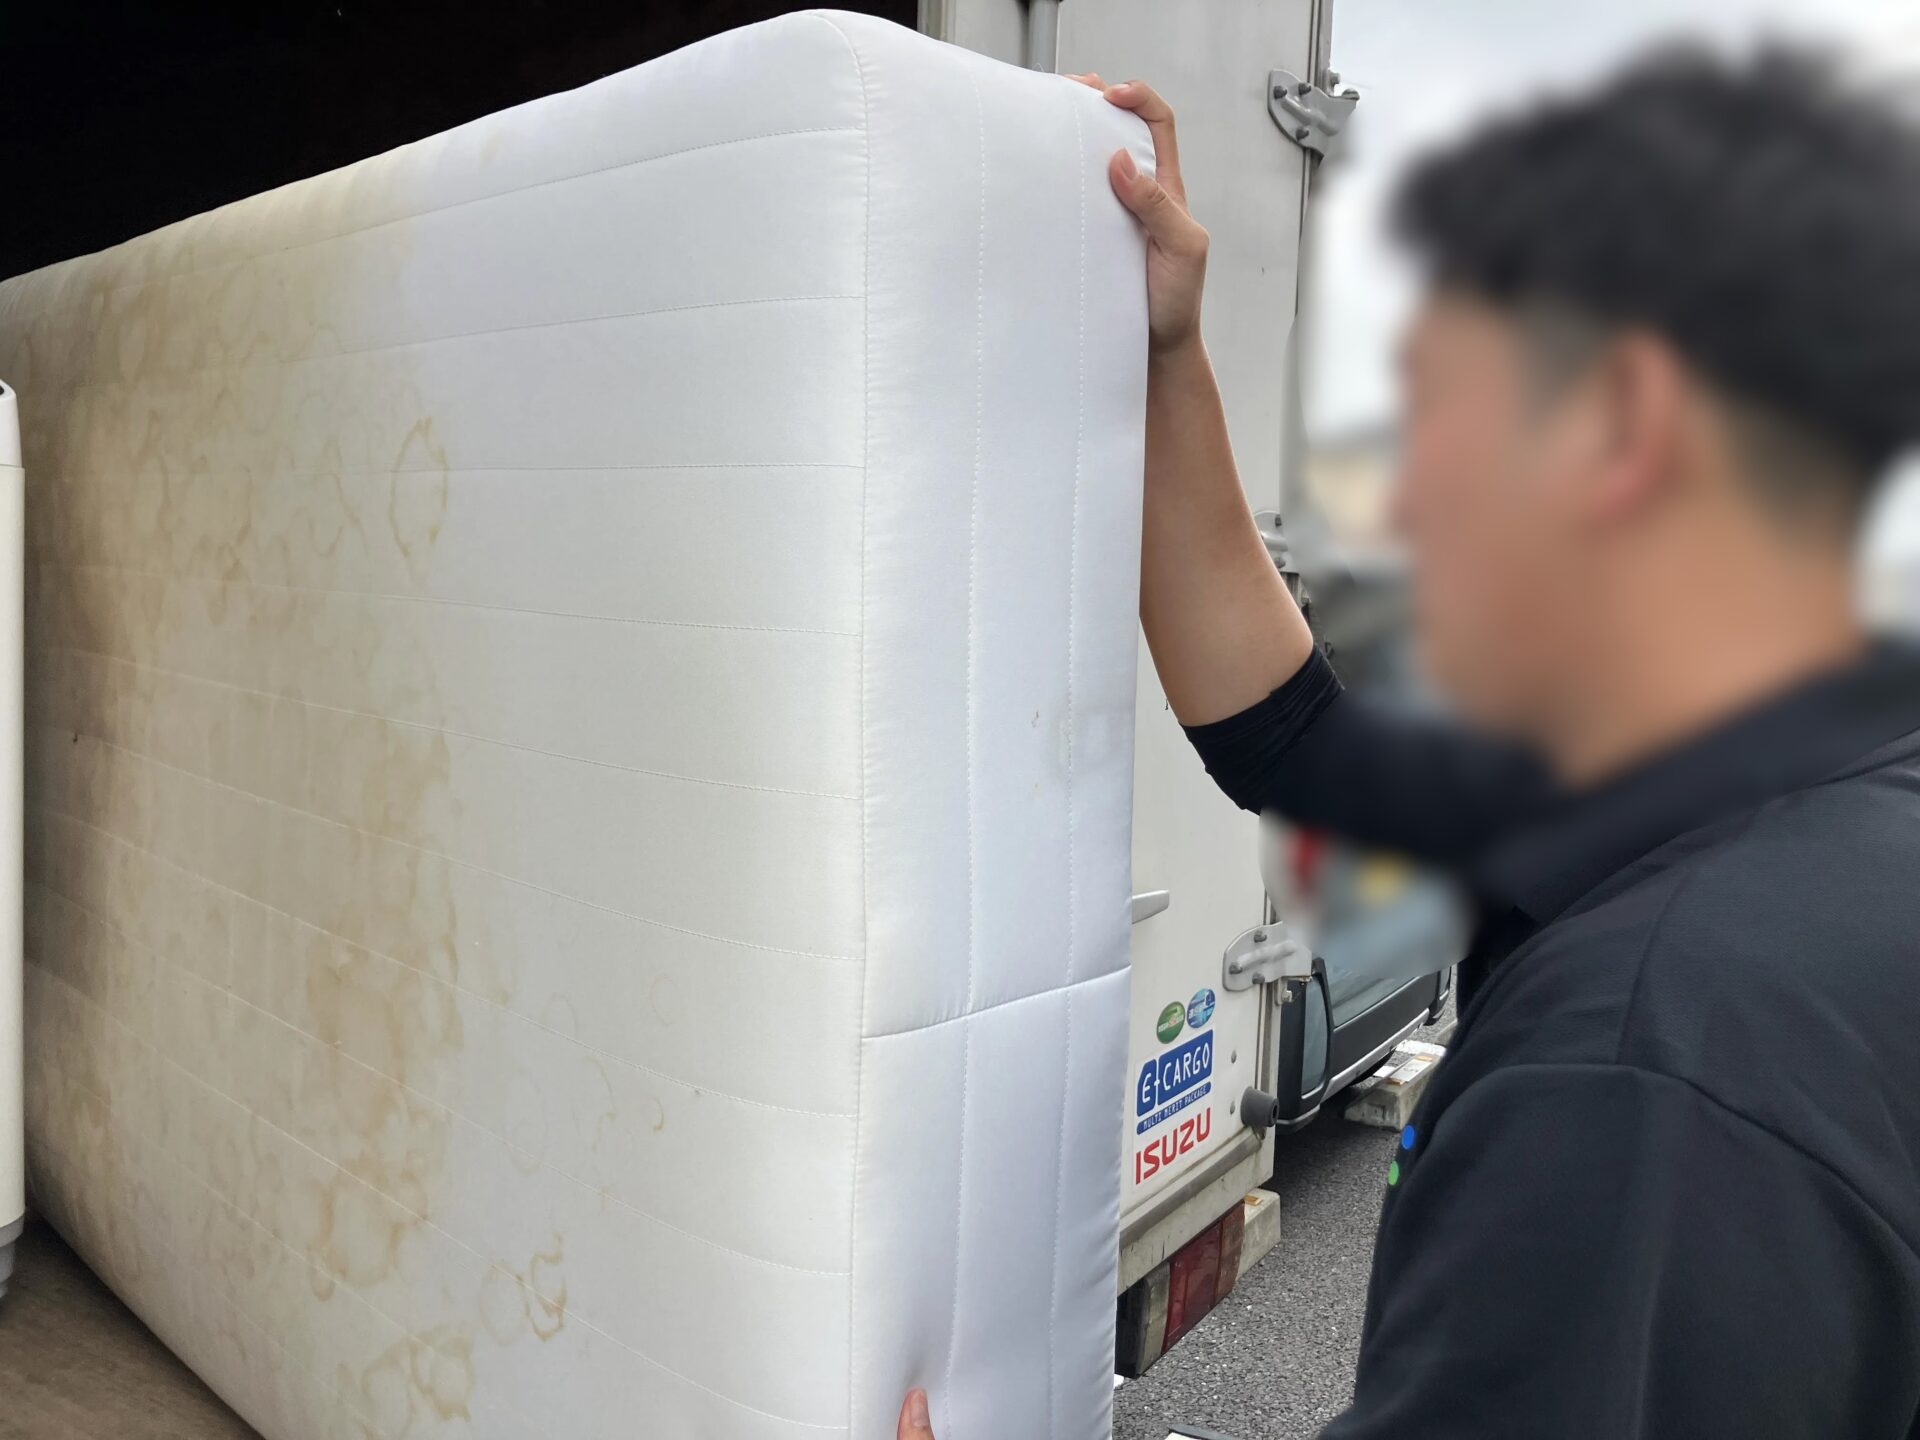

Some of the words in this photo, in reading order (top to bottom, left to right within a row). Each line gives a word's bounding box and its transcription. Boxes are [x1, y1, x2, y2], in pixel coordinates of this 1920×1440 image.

[1143, 1111, 1162, 1130] MULTI
[1164, 1099, 1182, 1116] MERIT
[1184, 1085, 1207, 1105] PACKAGE
[1136, 1107, 1211, 1185] ISUZU
